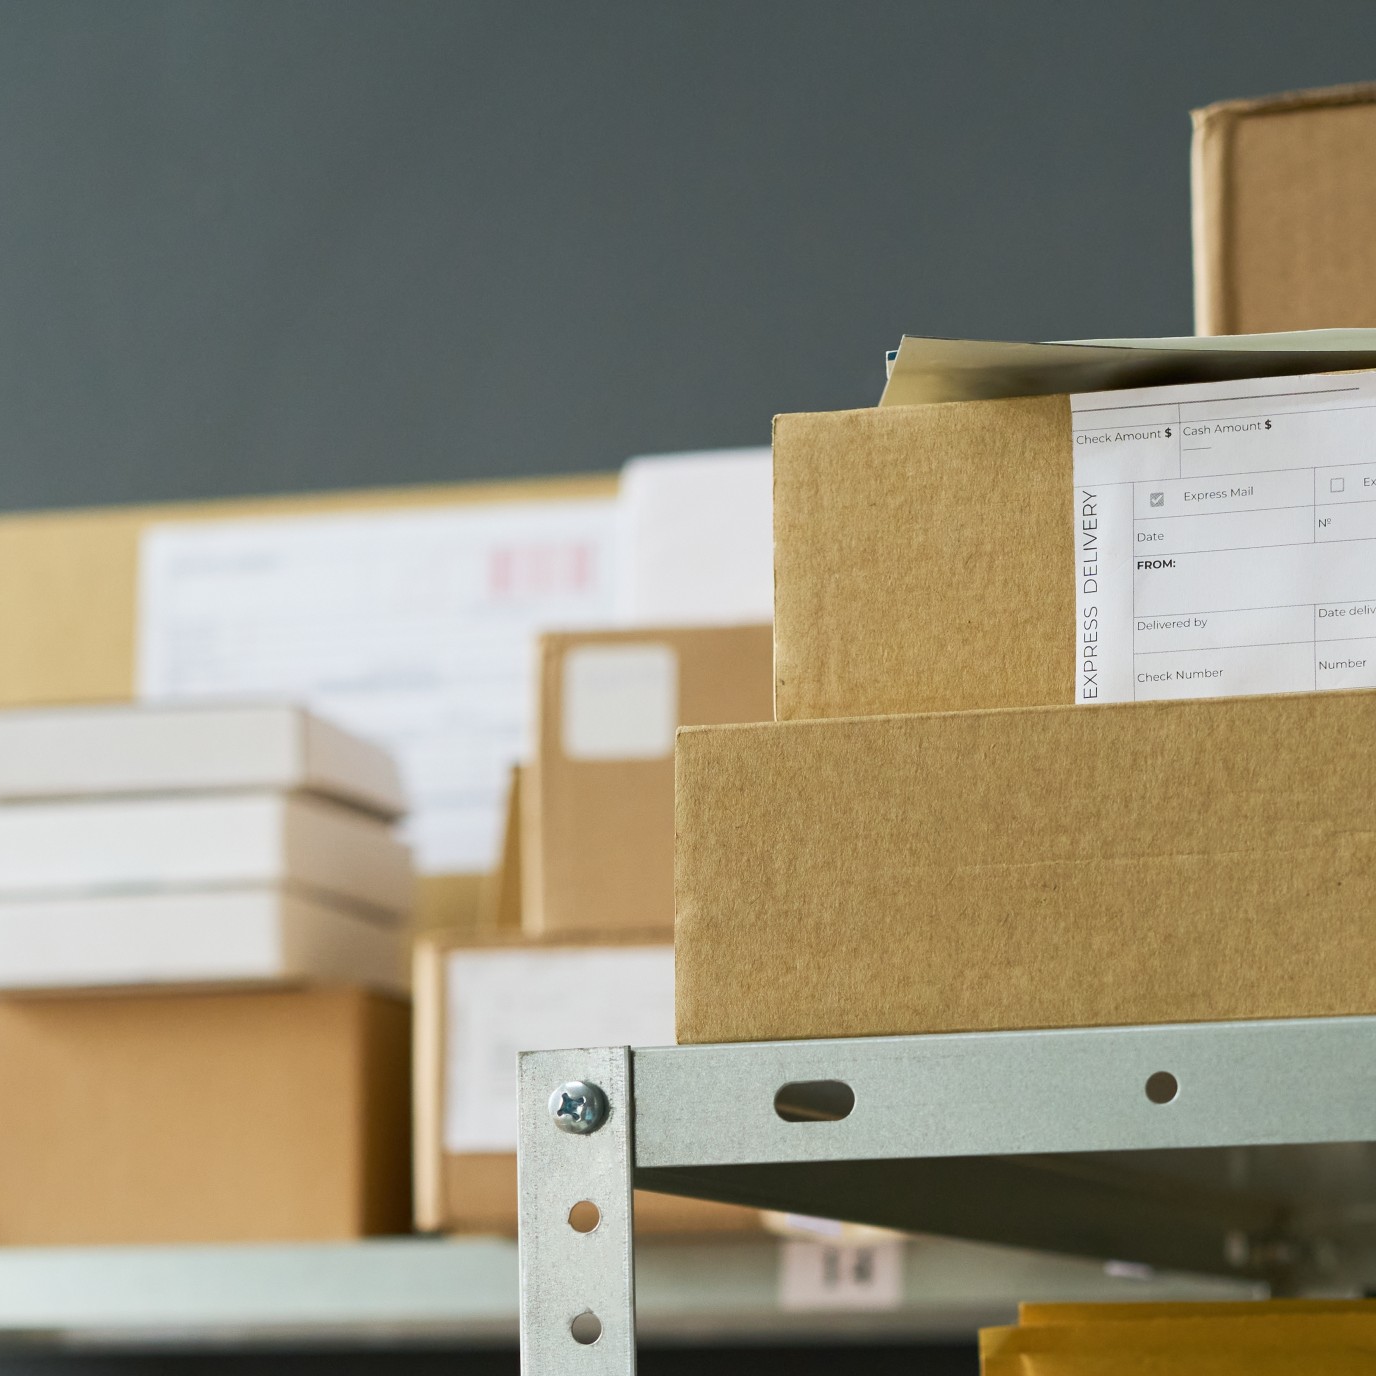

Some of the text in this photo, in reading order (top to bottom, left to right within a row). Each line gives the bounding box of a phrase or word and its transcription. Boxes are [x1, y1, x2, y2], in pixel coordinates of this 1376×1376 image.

[1182, 419, 1272, 436] Cash Amount $
[1076, 427, 1172, 445] Check Amount $
[1184, 486, 1254, 502] Express Mail
[1137, 532, 1165, 543] Date
[1137, 559, 1176, 570] FROM:
[1082, 489, 1098, 699] EXPRESS DELIVERY
[1318, 608, 1346, 618] Date
[1137, 618, 1208, 631] Delivered by
[1318, 659, 1367, 671] Number
[1137, 668, 1224, 683] Check Number
